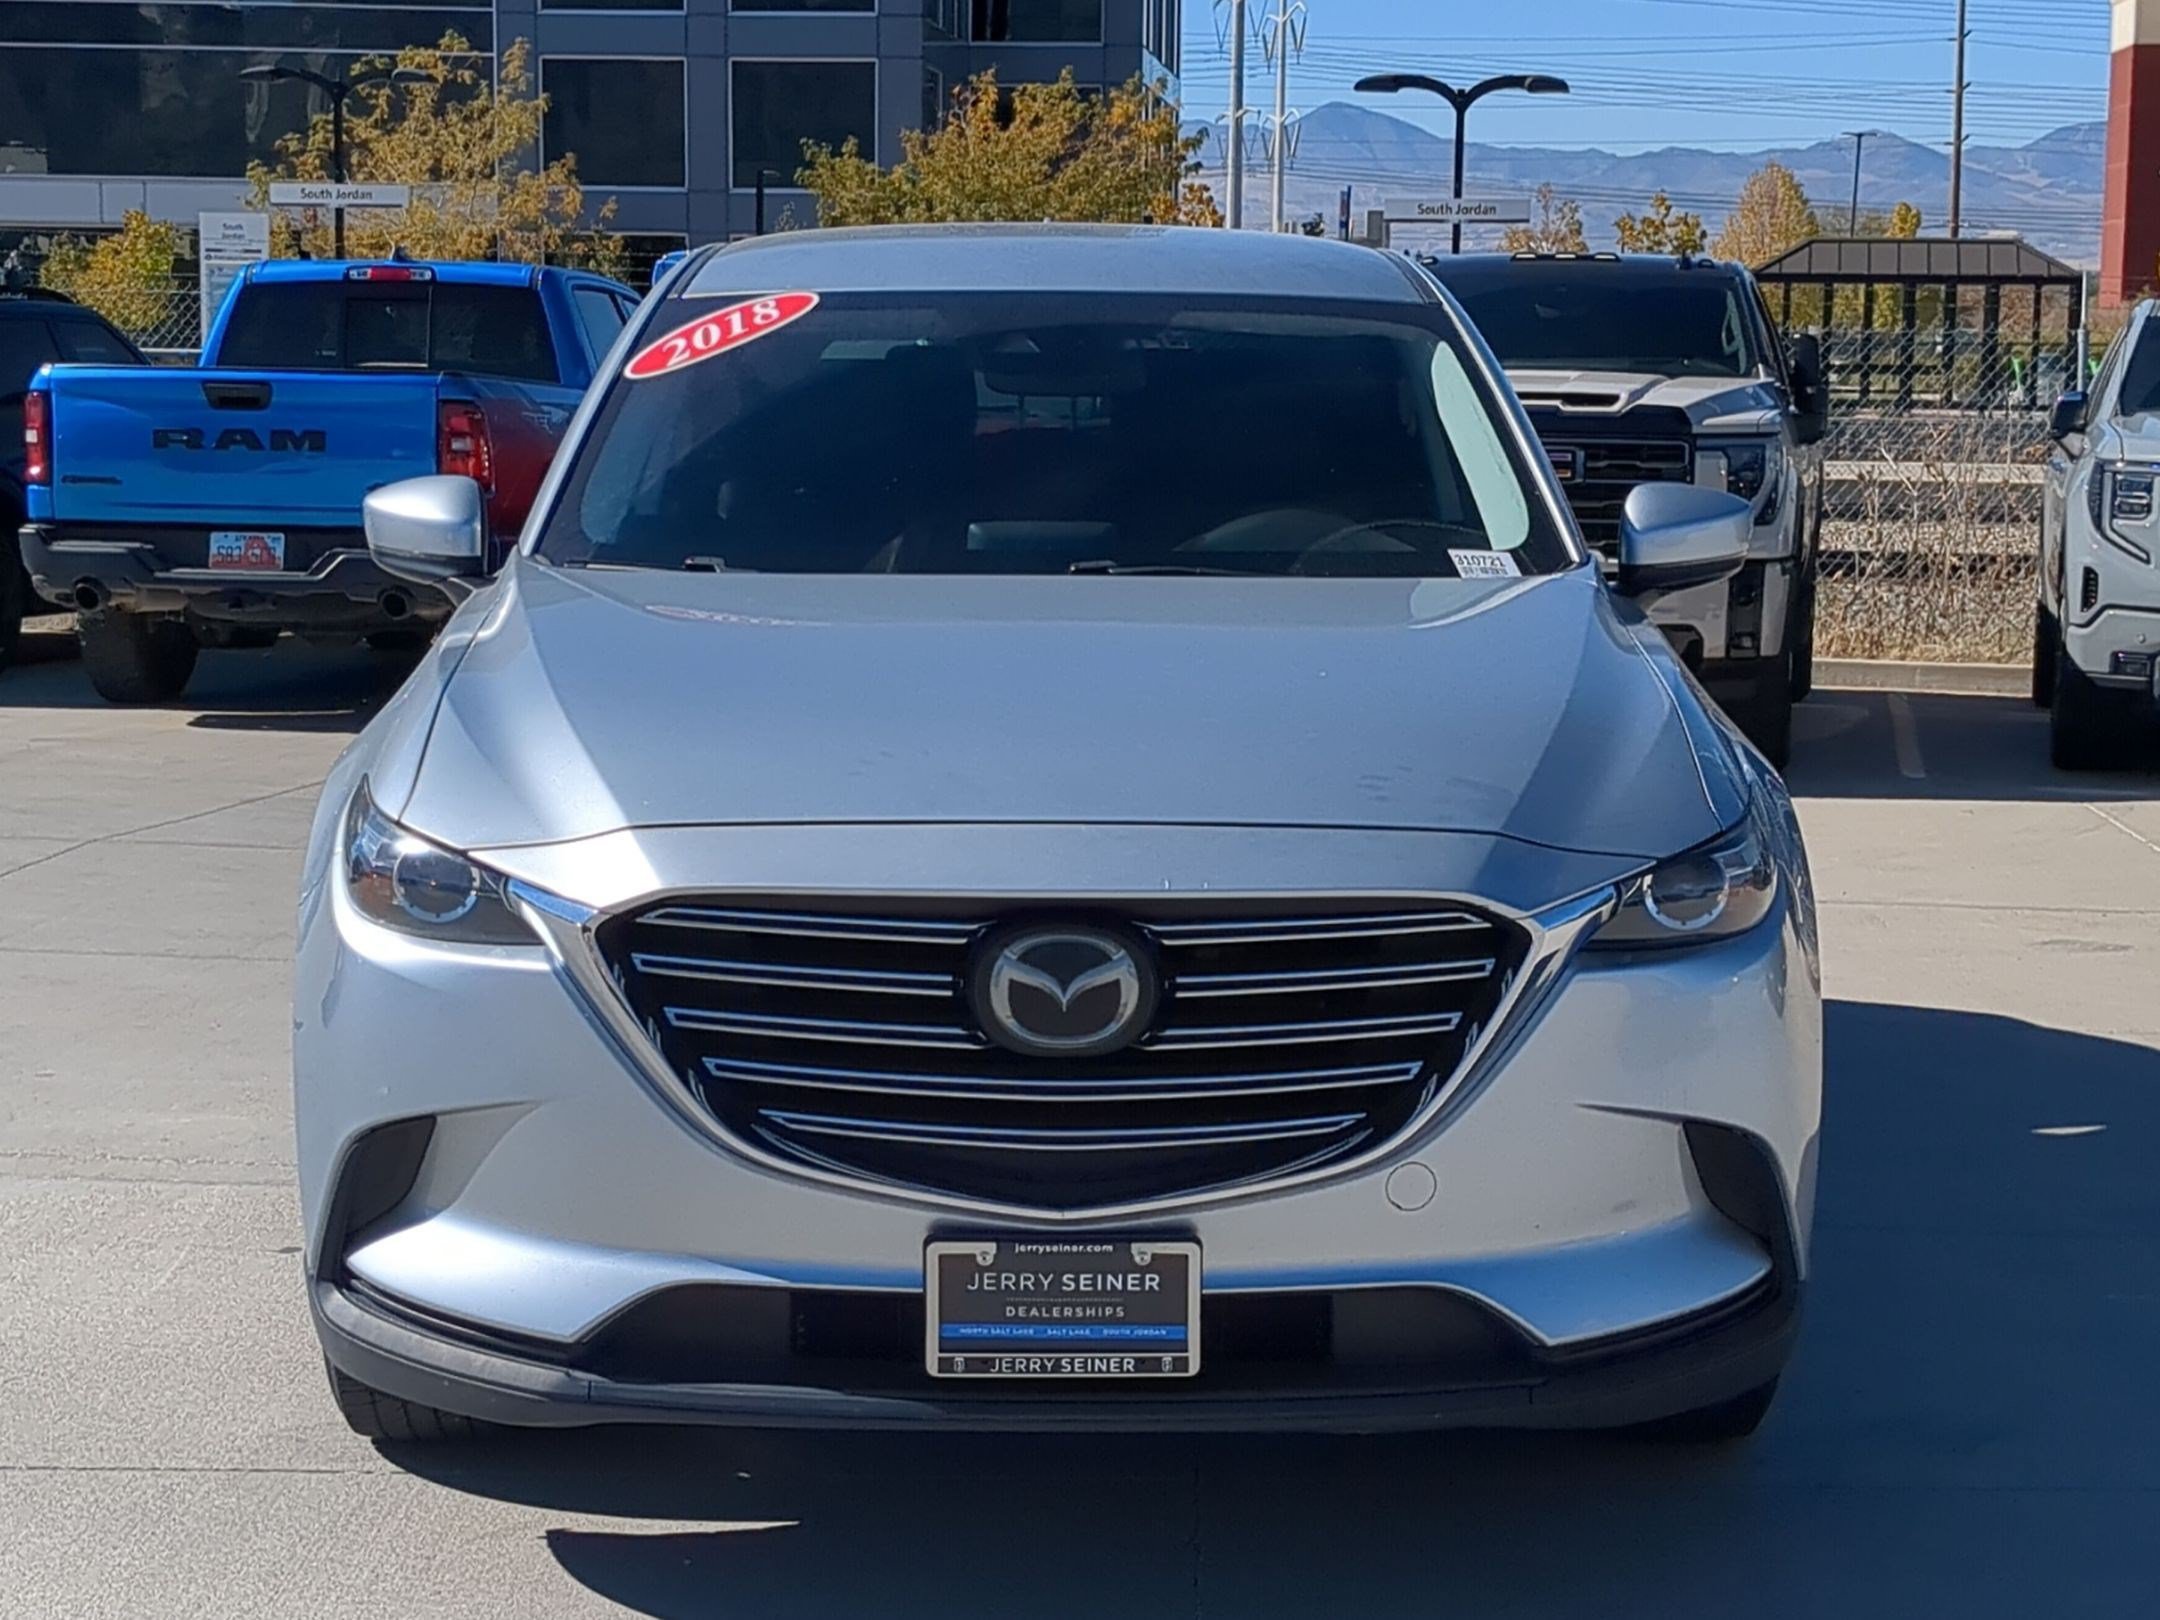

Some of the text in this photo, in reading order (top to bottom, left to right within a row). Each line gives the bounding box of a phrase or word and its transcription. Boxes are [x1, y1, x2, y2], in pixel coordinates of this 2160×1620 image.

[301, 187, 373, 200] South Jordan
[1417, 203, 1497, 215] South Jordan
[662, 299, 780, 367] 2018
[152, 428, 326, 452] RAM
[1014, 1242, 1114, 1255] jerryseiner.com
[966, 1272, 1160, 1292] JERRY SEINER
[1005, 1306, 1125, 1318] DEALERSHIPS
[990, 1358, 1135, 1374] JERRY SEINER
